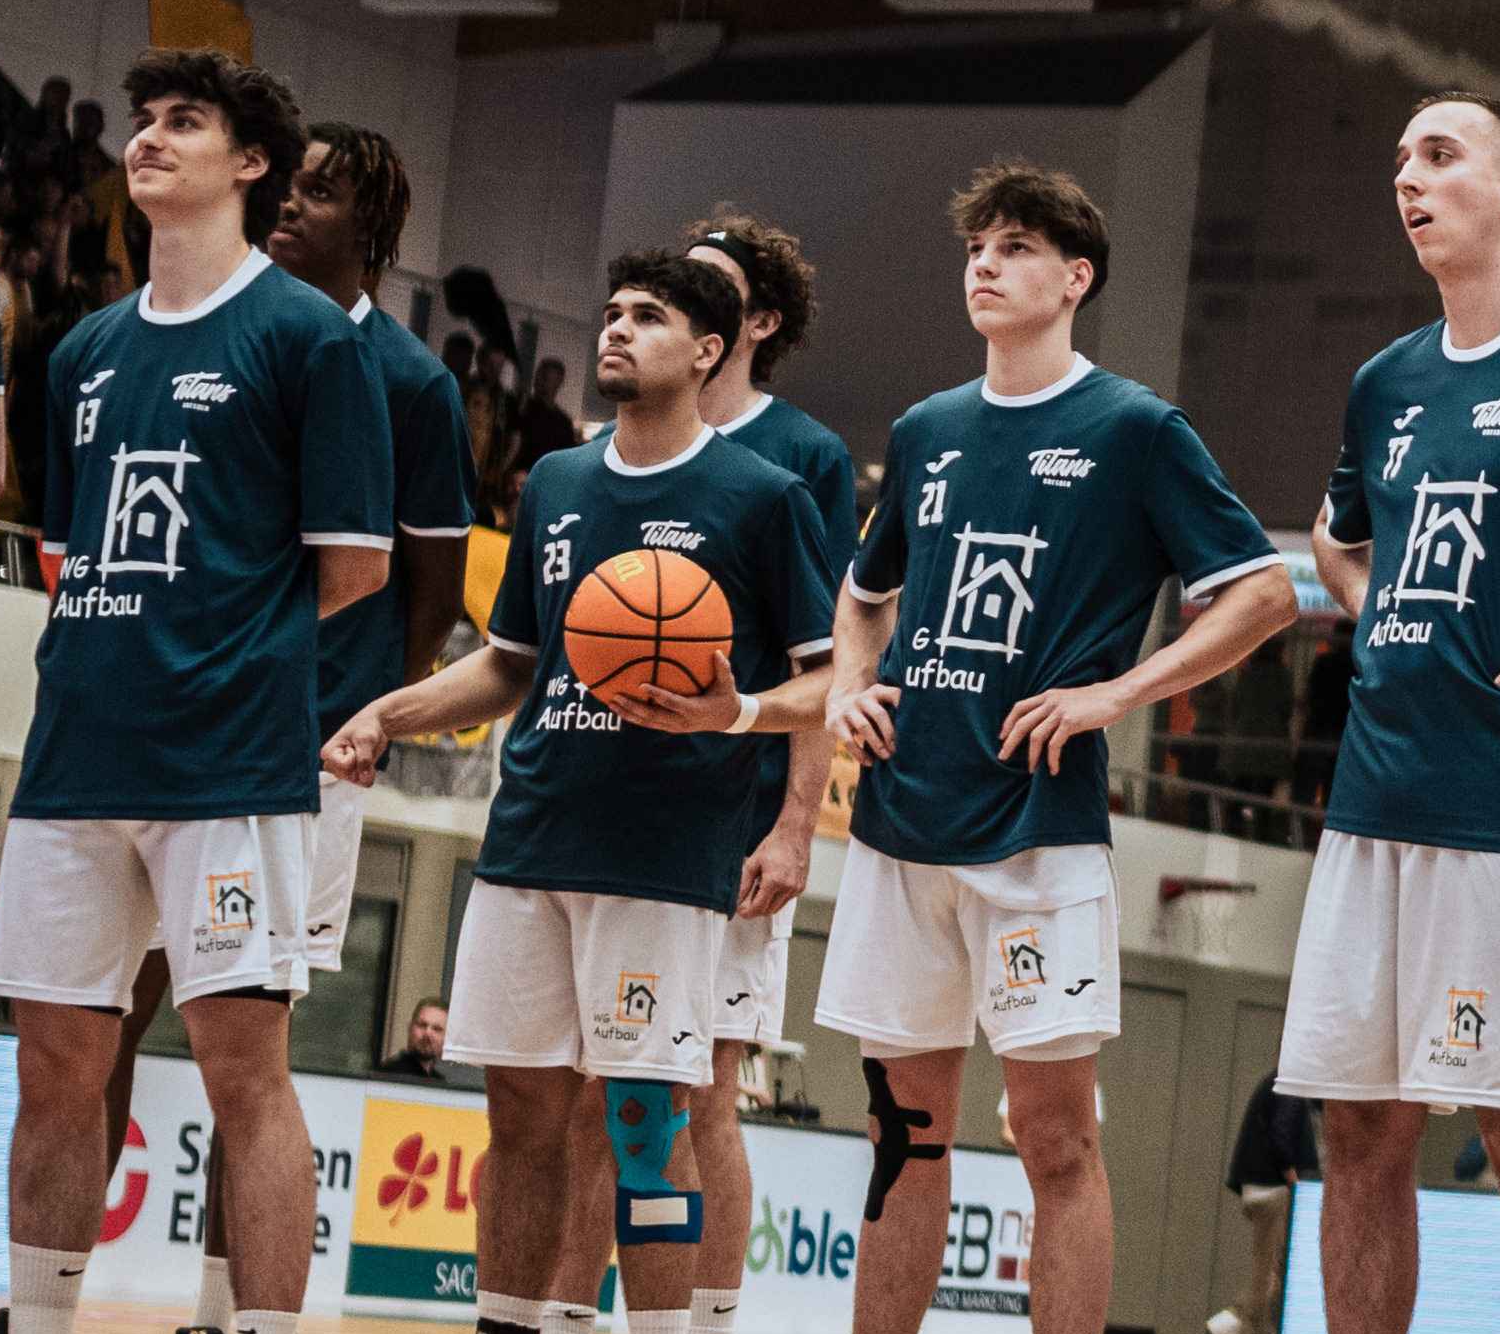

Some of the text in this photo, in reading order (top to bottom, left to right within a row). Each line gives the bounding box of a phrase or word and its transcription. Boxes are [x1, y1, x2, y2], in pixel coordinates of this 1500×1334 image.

[171, 371, 238, 403] Titans
[74, 398, 102, 447] 13
[1028, 447, 1097, 478] Titans
[918, 479, 947, 527] 21
[640, 520, 706, 550] Titans
[543, 539, 572, 586] 23
[51, 586, 143, 618] Aufbau
[904, 658, 986, 694] ufbau
[536, 701, 622, 732] Aufbau
